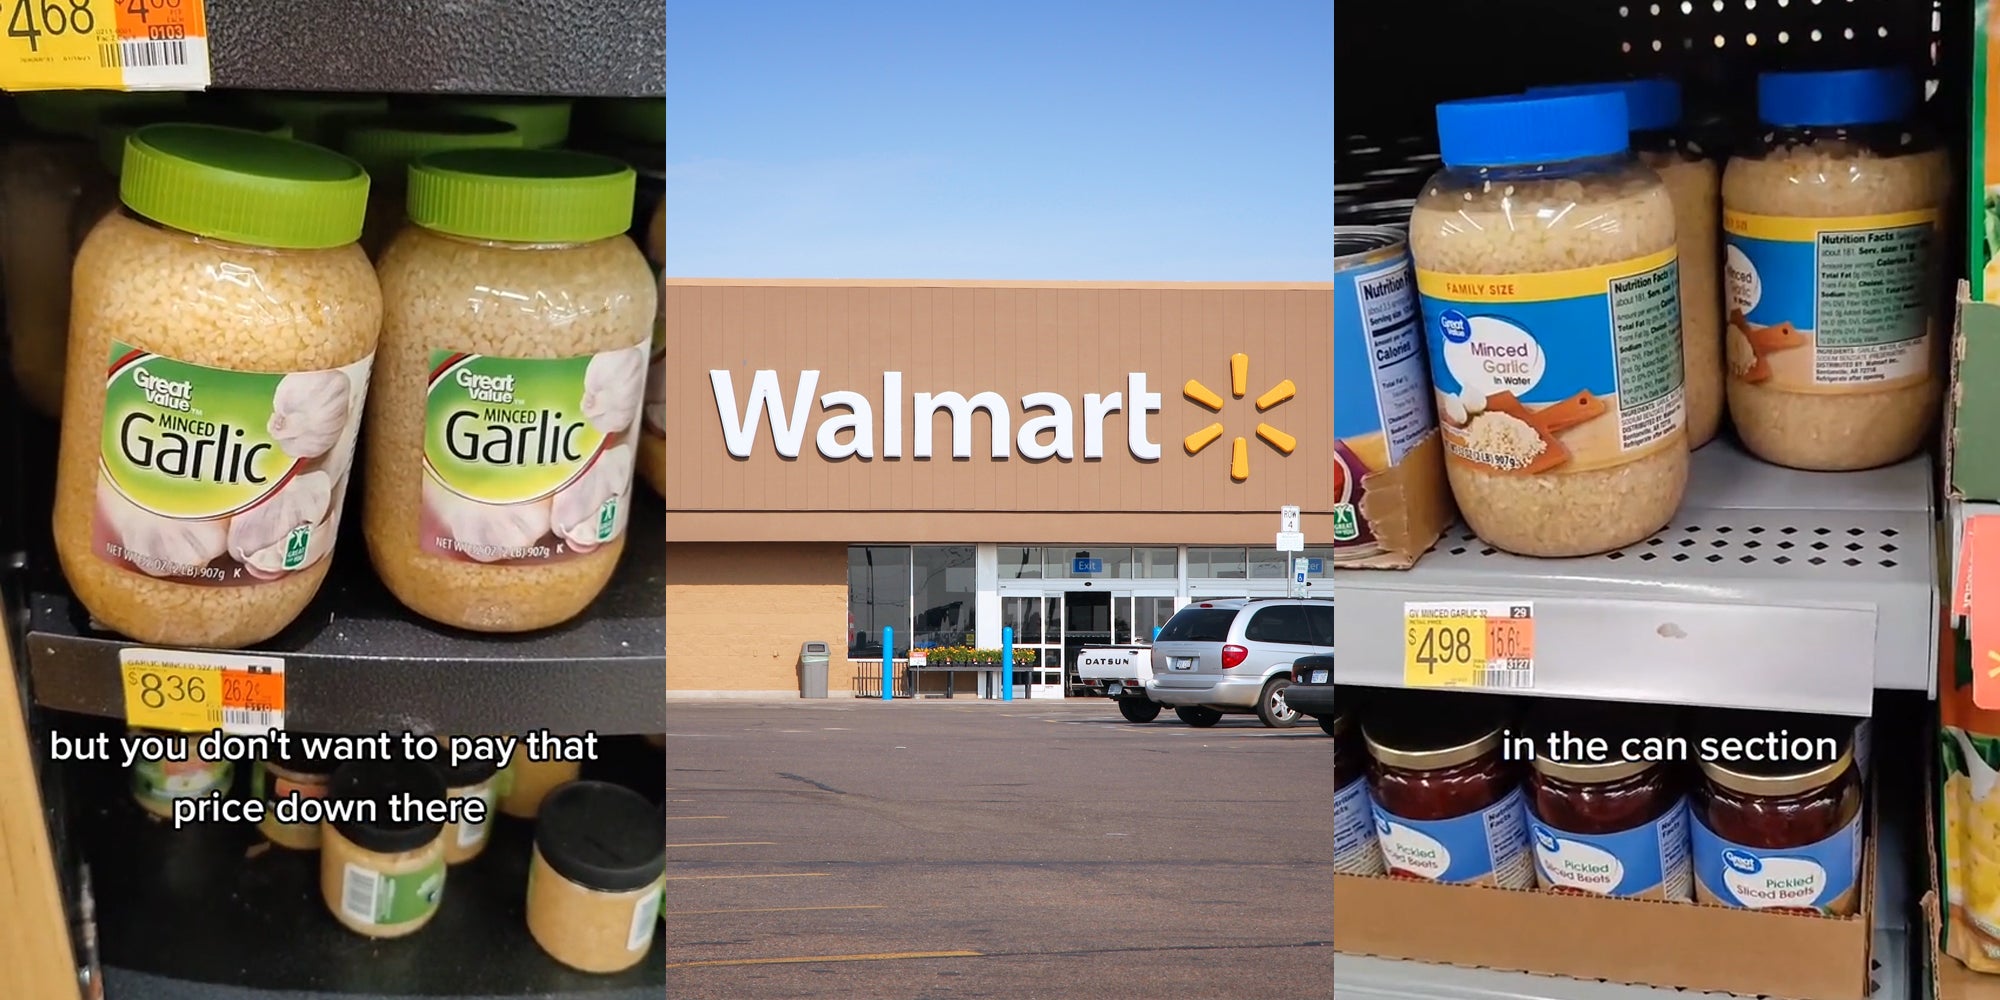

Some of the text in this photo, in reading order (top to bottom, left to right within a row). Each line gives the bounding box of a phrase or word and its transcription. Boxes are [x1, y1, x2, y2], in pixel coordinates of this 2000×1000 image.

[149, 25, 183, 40] 0103
[1821, 232, 1894, 245] Nutrition Facts
[1363, 276, 1405, 301] Nutrition
[1447, 282, 1515, 295] FAMILY SIZE
[1614, 277, 1652, 294] Nutrition
[1441, 316, 1464, 331] Great
[1376, 341, 1411, 361] Calories
[1471, 342, 1528, 357] Minced
[1483, 359, 1529, 374] Garlic
[132, 366, 193, 400] Great
[456, 367, 515, 393] Great
[1504, 377, 1531, 385] Water
[145, 389, 190, 412] Value
[468, 387, 513, 403] Value
[484, 408, 537, 424] MINCED
[709, 369, 1162, 460] Walmart
[158, 413, 216, 437] MINCED
[446, 410, 585, 465] Garlic
[120, 411, 272, 483] Garlic
[1495, 454, 1516, 467] 907g
[1283, 510, 1297, 519] ROW
[436, 536, 453, 549] NET
[527, 547, 550, 558] 907g
[556, 543, 564, 554] K
[106, 542, 123, 557] NET
[200, 567, 225, 580] 907g
[233, 567, 242, 578] K
[1078, 561, 1095, 570] Exit
[1409, 609, 1488, 618] GV MINCED GARLIC 32
[1513, 607, 1526, 618] 29
[1408, 627, 1472, 674] $498
[1507, 659, 1529, 670] 3127
[127, 671, 206, 708] $836
[1408, 855, 1438, 869] Beets
[1564, 859, 1609, 873] Pickled
[1577, 871, 1611, 884] Beets
[1766, 875, 1814, 888] Pickled
[1736, 884, 1814, 899] Sliced Beets
